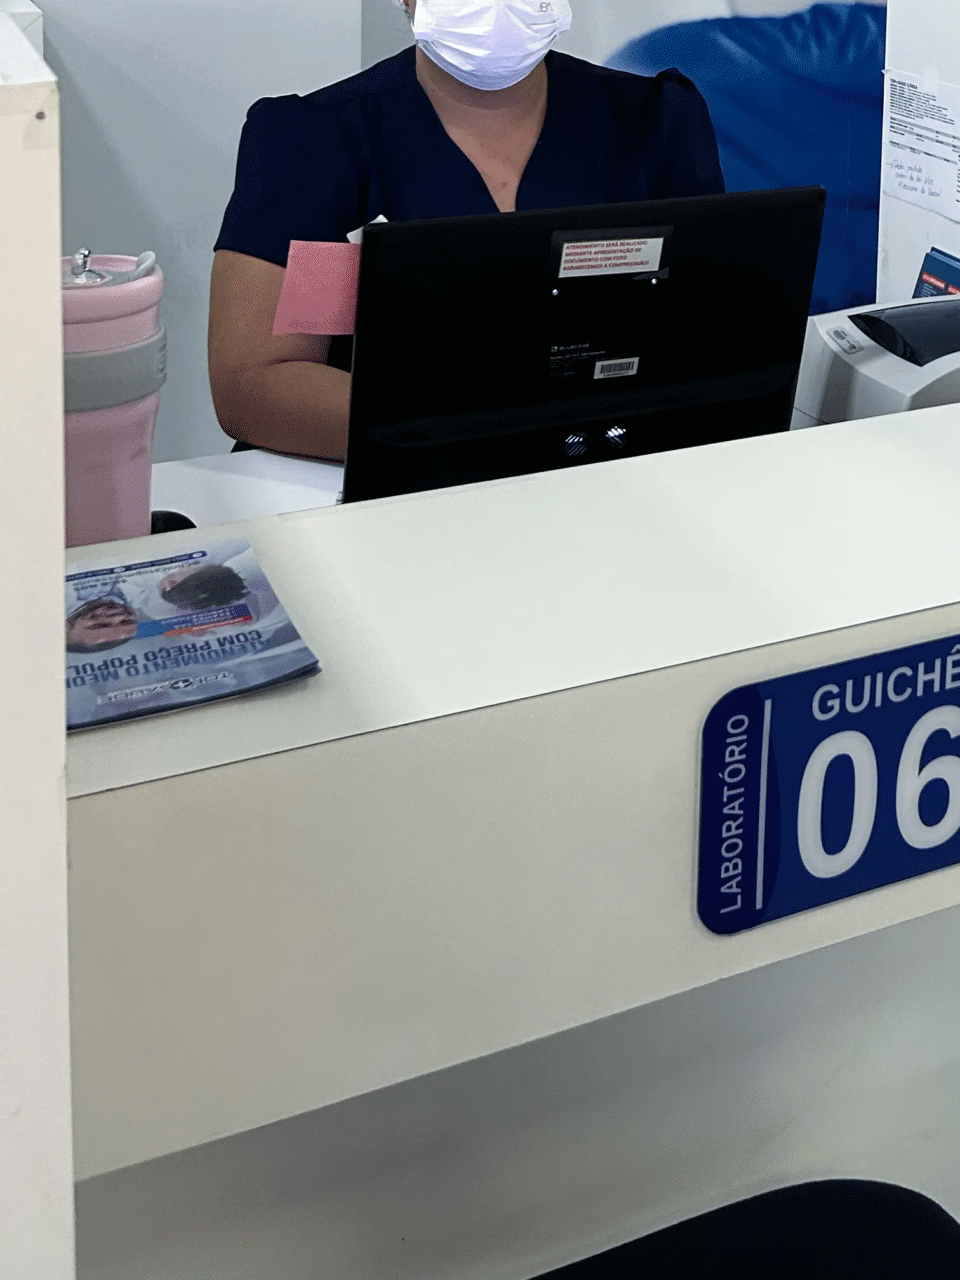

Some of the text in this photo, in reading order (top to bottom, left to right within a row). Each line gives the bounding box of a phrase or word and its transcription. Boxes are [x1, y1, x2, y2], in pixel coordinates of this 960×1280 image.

[594, 248, 634, 256] APRESENTAÇÃO
[143, 638, 213, 662] PREÇO
[216, 629, 263, 647] COM
[126, 637, 270, 677] ATENDIMENTO
[719, 714, 749, 914] LABORATÓRIO
